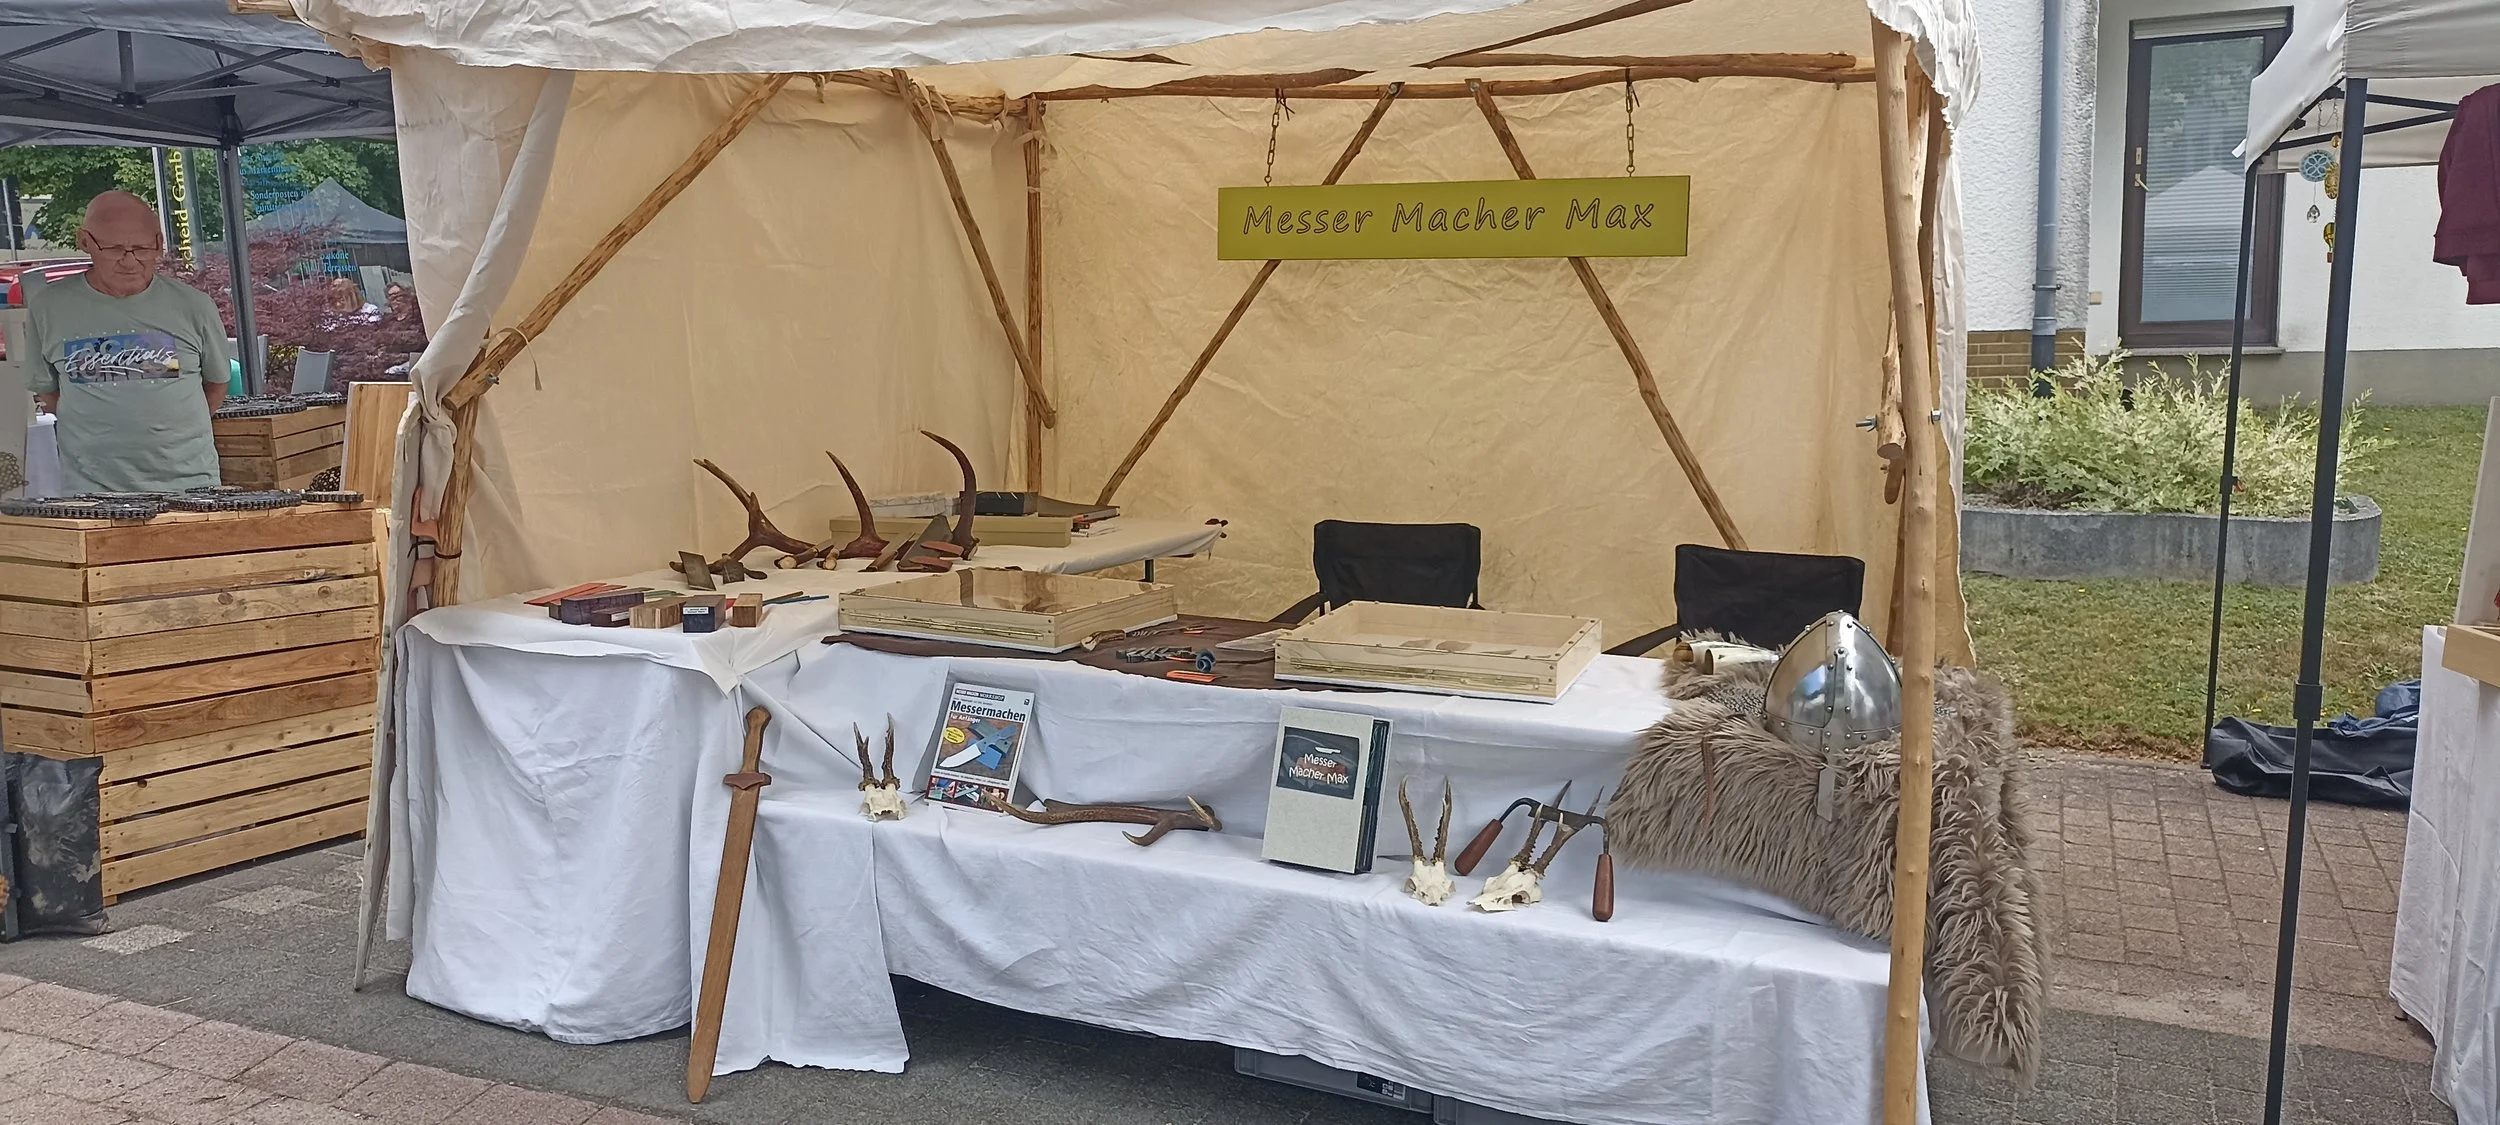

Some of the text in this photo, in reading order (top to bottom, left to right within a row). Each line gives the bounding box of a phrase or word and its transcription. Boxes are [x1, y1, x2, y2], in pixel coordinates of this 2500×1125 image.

[168, 147, 187, 203] Gmb
[1242, 197, 1655, 235] Messer Macher Max
[63, 345, 179, 374] Essentials
[950, 700, 1026, 721] Messermachen
[1304, 753, 1337, 768] Messer
[1289, 766, 1349, 784] Macher Max
